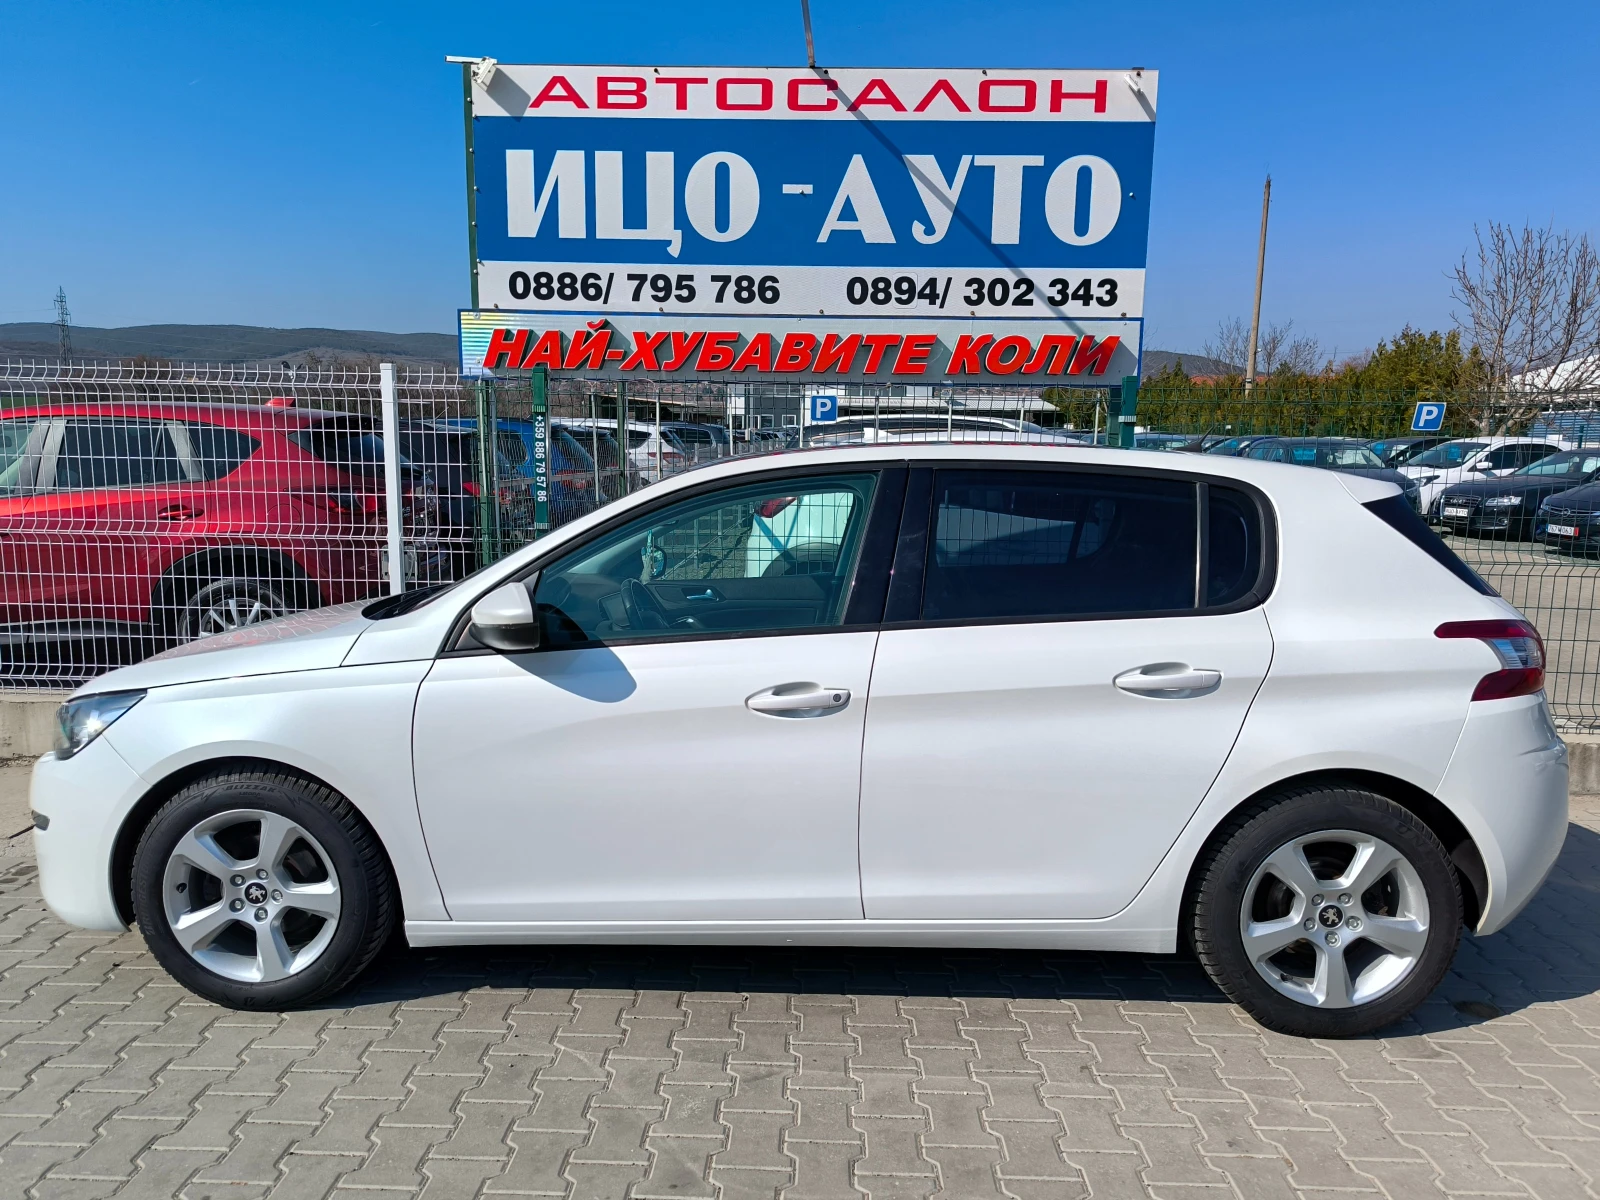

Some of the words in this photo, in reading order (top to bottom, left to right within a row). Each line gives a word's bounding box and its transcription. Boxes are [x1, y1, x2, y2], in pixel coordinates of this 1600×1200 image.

[529, 75, 1108, 114] АВТОСАЛОН
[505, 150, 760, 258] ИЦО
[508, 270, 615, 305] 0886/
[626, 273, 697, 304] 795
[710, 274, 781, 305] 786
[846, 276, 953, 308] 0894/
[963, 277, 1035, 307] 302
[1046, 278, 1118, 307] 343
[482, 319, 937, 375] НАЙ-ХУБАВИТЕ
[947, 334, 1121, 376] КОЛИ
[816, 398, 832, 419] P
[1418, 405, 1438, 426] P
[535, 415, 545, 437] +359
[535, 441, 545, 459] 886
[536, 461, 546, 473] 79
[537, 476, 547, 488] 57
[537, 490, 547, 502] 86
